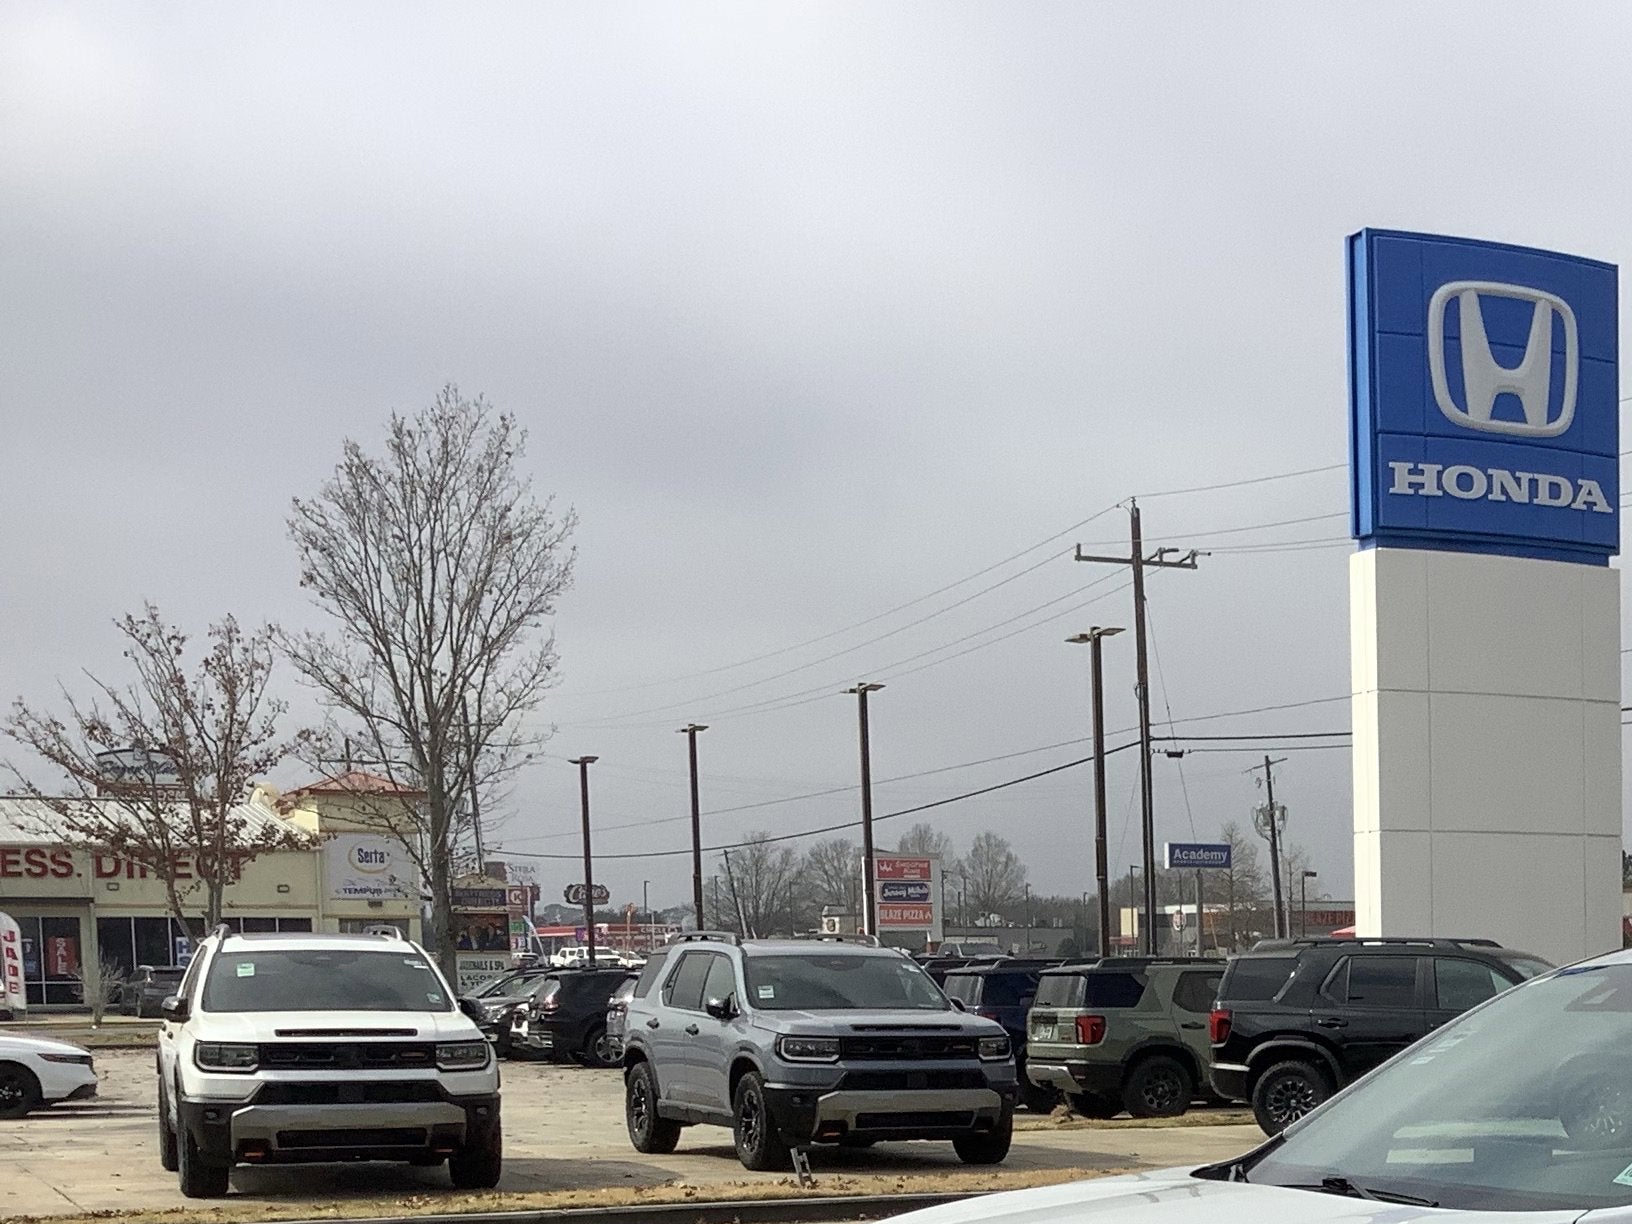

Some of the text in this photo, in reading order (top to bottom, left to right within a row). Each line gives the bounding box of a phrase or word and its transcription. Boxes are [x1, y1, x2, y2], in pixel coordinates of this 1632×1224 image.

[1389, 461, 1613, 513] HONDA
[357, 848, 385, 864] Serta
[1173, 848, 1228, 863] Academy
[56, 938, 67, 974] SALE
